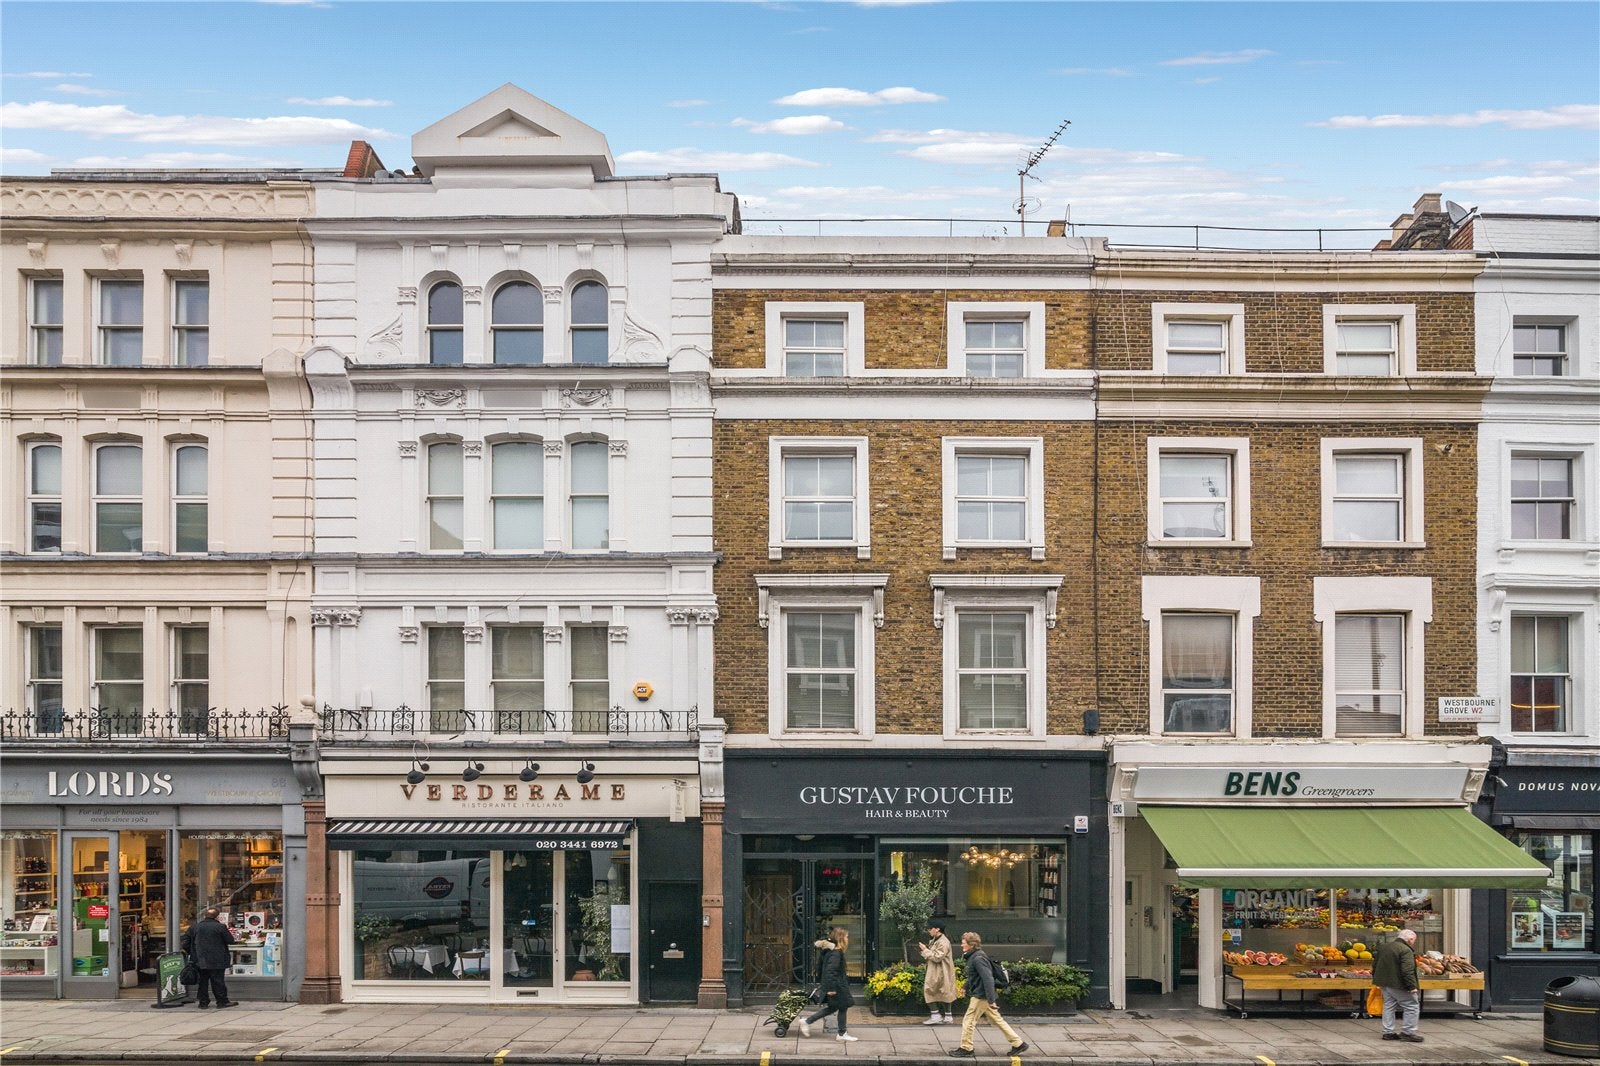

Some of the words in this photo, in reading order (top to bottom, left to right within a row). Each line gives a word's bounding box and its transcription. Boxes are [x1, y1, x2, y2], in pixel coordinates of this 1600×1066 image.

[48, 771, 173, 796] LORDS
[1224, 771, 1301, 796] BENS
[1301, 785, 1375, 798] Greengrocers
[1518, 782, 1565, 791] DOMUS
[400, 784, 625, 801] VERDERAME
[799, 786, 900, 804] GUSTAV
[905, 786, 1014, 804] FOUCHE
[103, 809, 121, 817] your
[536, 840, 557, 849] 020
[560, 840, 587, 849] 3441
[590, 840, 618, 849] 6972
[1235, 890, 1318, 909] ORGANIC
[1235, 911, 1257, 919] FRUIT
[1260, 911, 1268, 919] &
